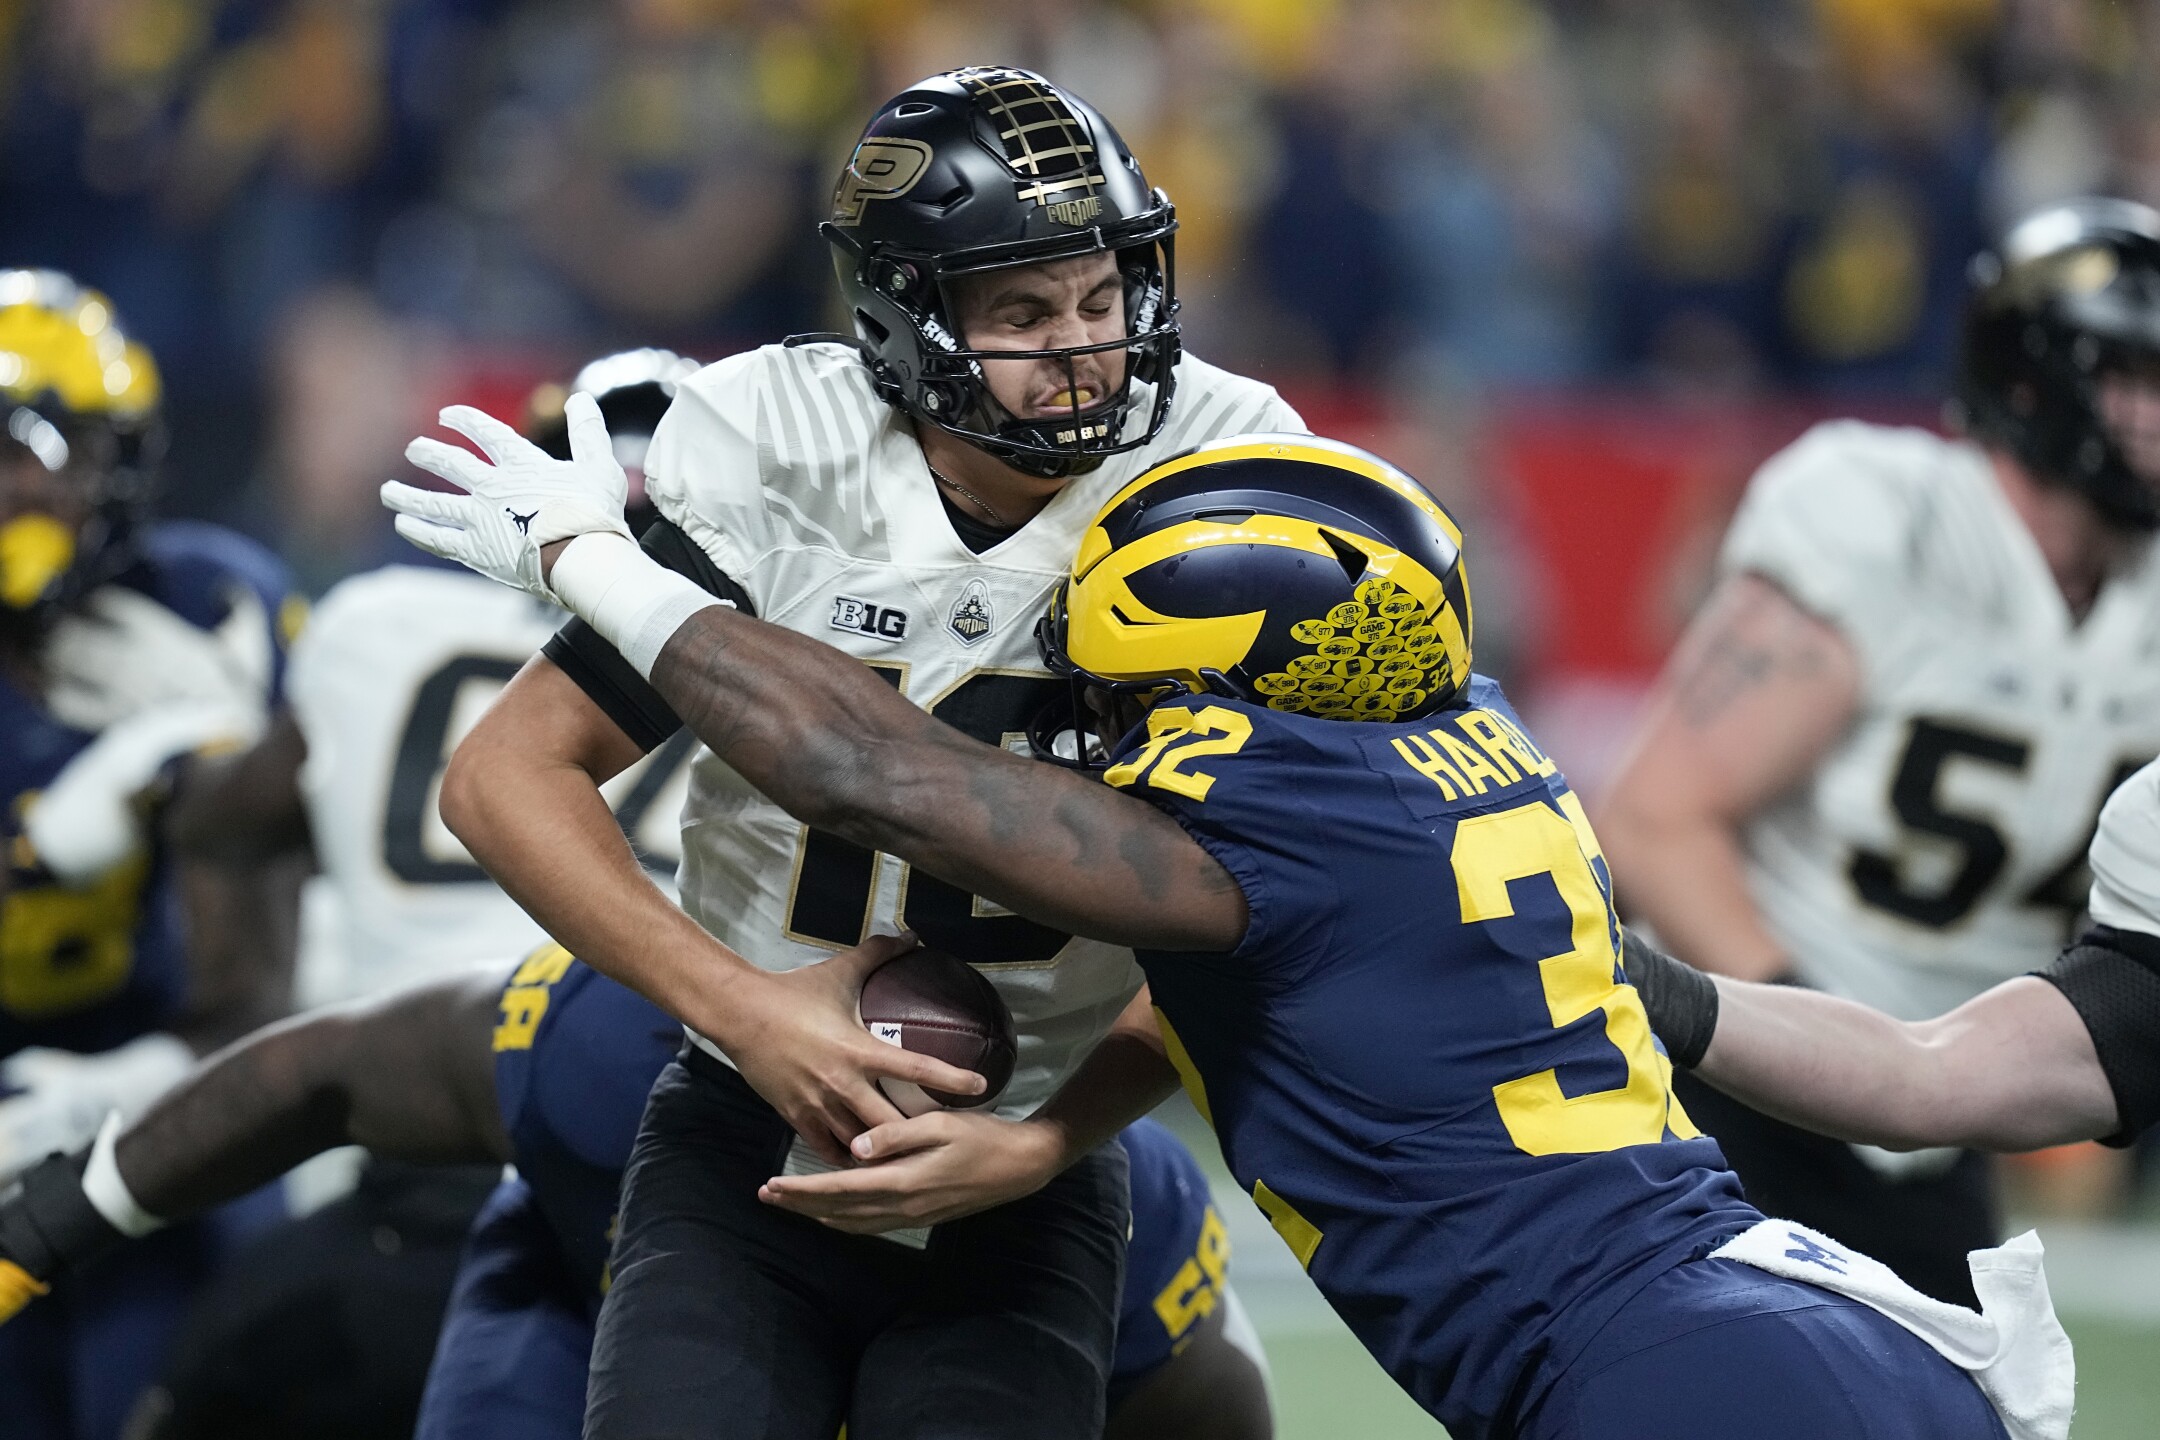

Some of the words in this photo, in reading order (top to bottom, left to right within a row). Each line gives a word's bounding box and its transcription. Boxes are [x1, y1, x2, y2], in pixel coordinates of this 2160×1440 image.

[1046, 196, 1104, 226] PURDUE
[1056, 420, 1095, 444] BOIER
[1095, 424, 1108, 437] UP
[954, 616, 988, 635] PURDUE
[1318, 628, 1331, 636] 977
[1360, 622, 1386, 635] GAME
[1341, 646, 1354, 655] 977
[1314, 661, 1327, 670] 987
[1427, 662, 1450, 694] 32
[1276, 696, 1304, 706] GAME
[1103, 705, 1254, 803] 32
[1450, 789, 1706, 1158] 3
